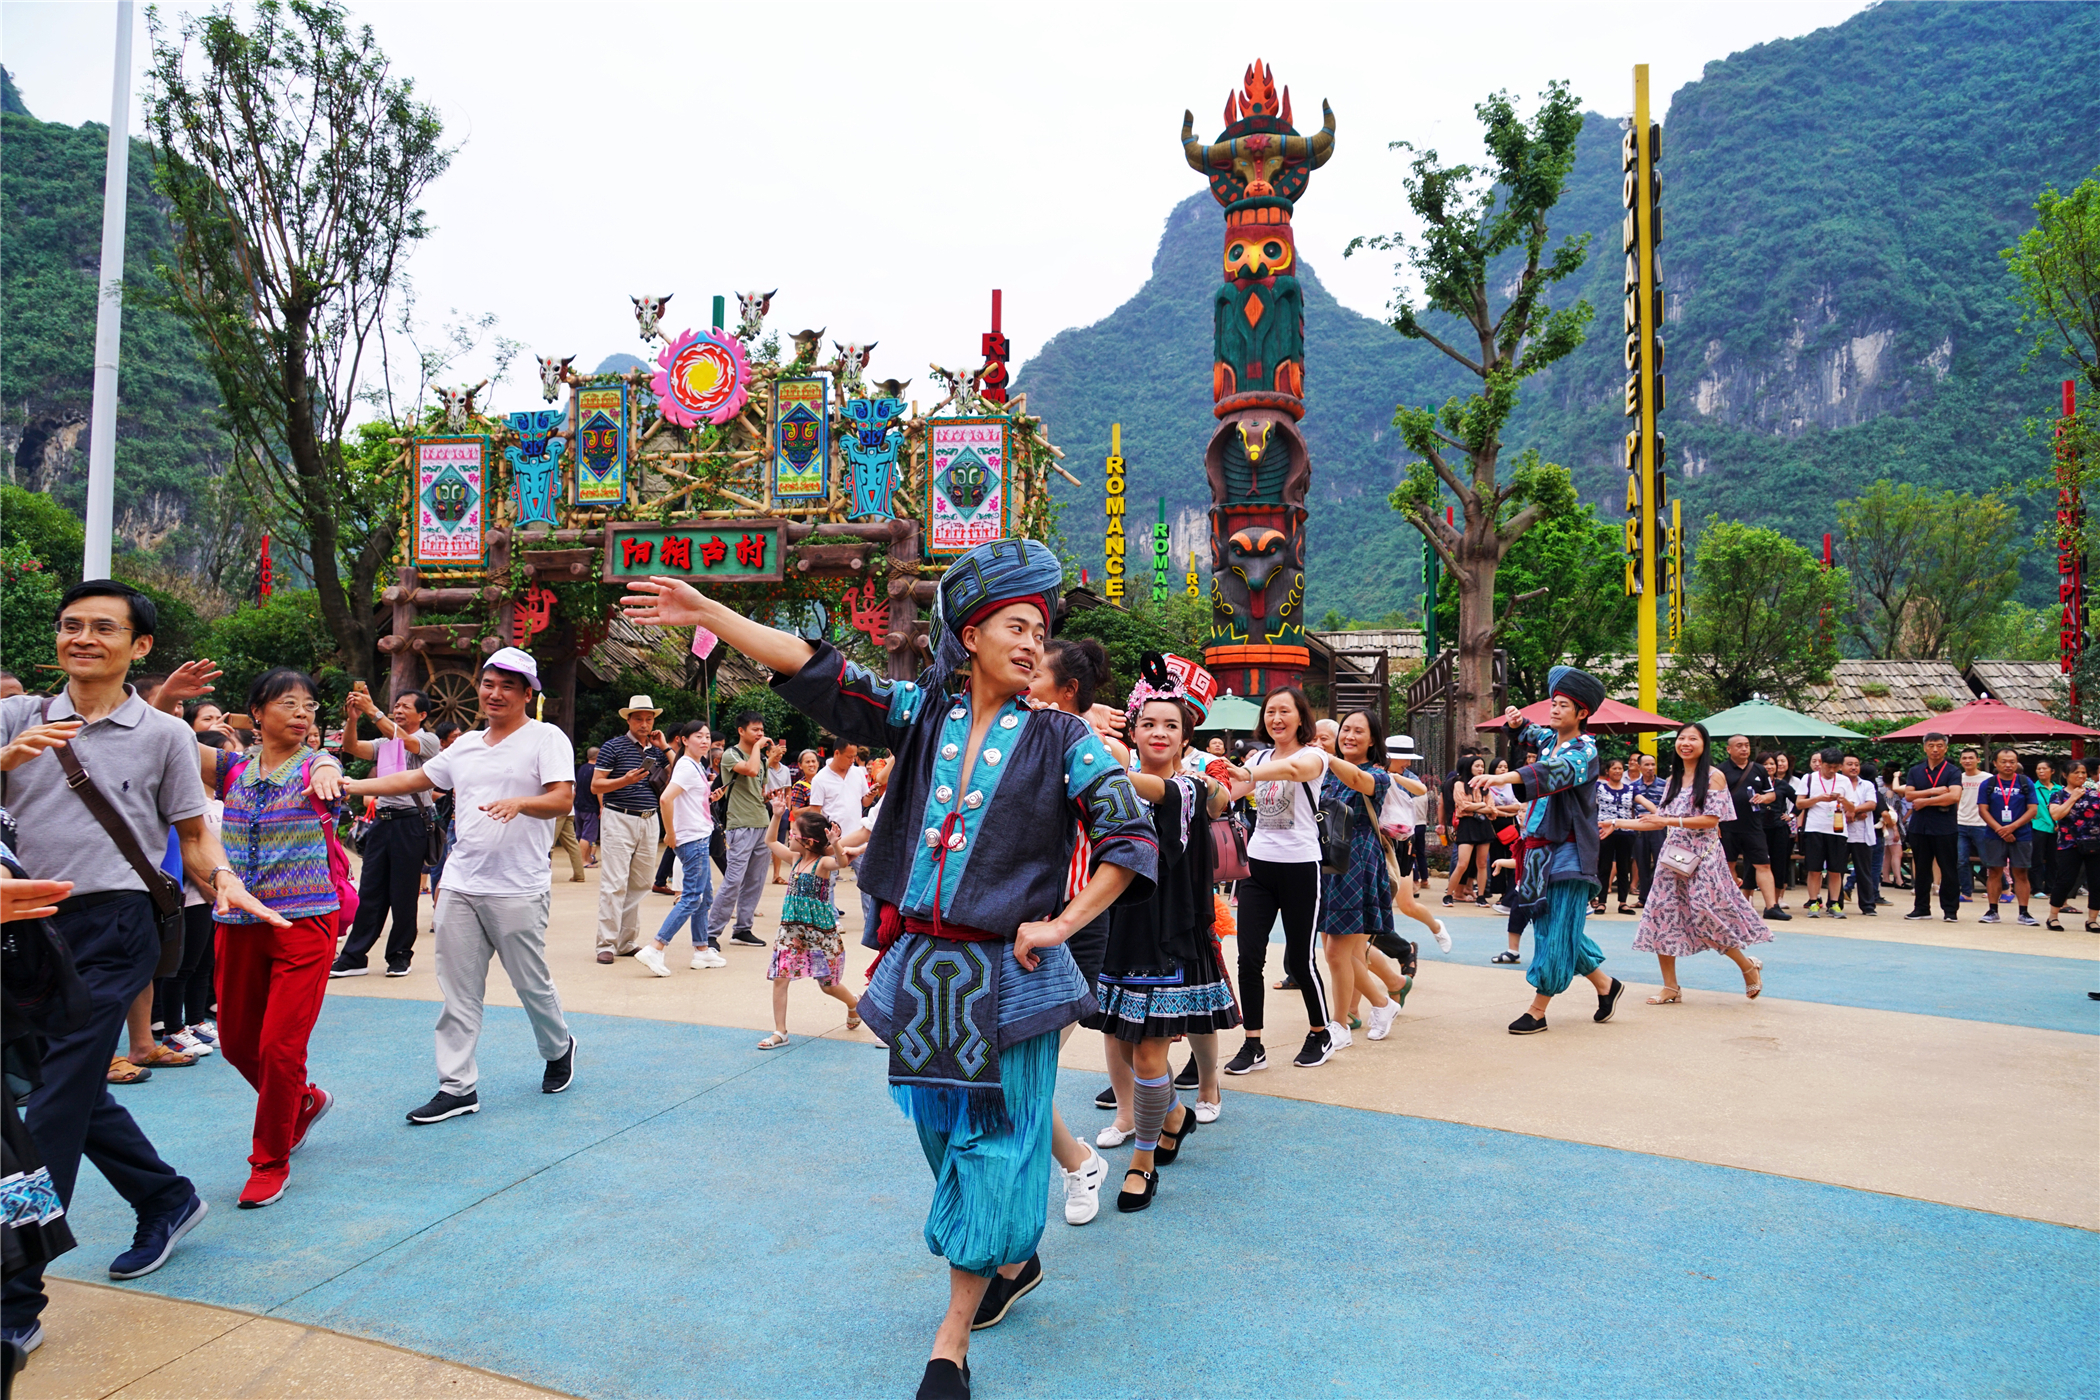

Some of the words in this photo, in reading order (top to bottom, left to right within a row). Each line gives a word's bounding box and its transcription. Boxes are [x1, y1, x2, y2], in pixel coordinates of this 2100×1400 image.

[1622, 128, 1637, 416] ROMANCE
[620, 533, 766, 570] 阳朔古村
[1105, 456, 1126, 597] ROMANCE
[1625, 430, 1638, 597] PARK
[261, 556, 273, 607] ROM
[2059, 583, 2076, 674] PARK
